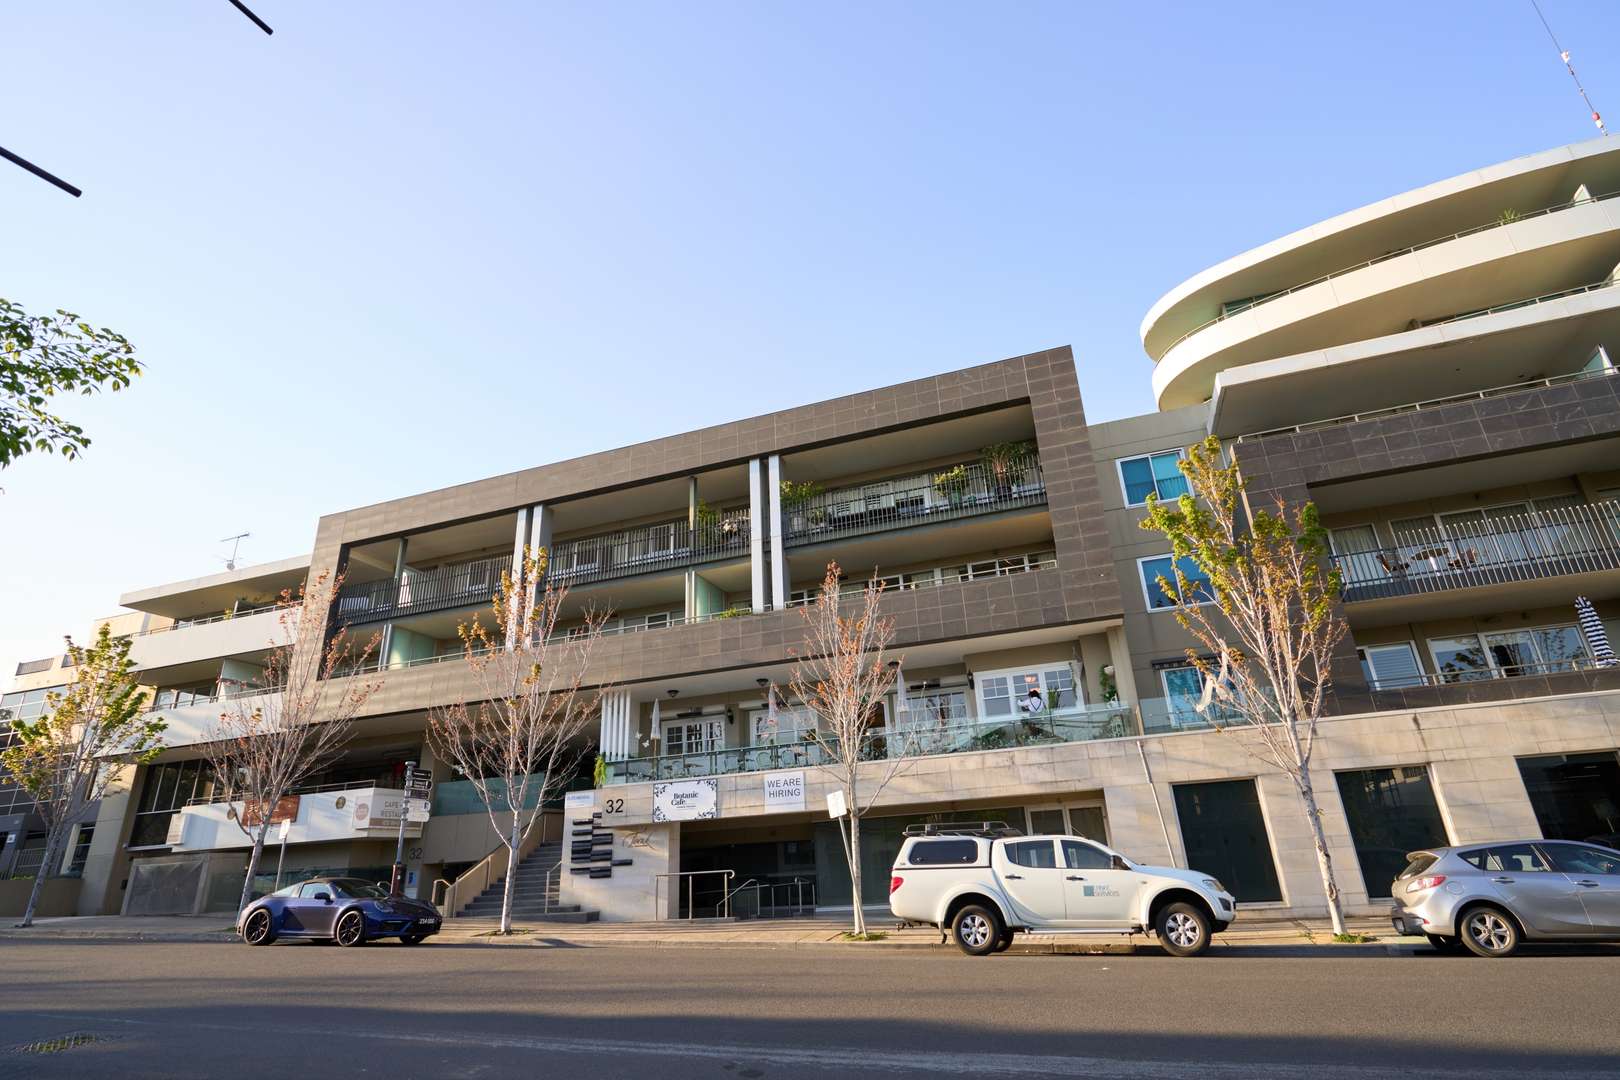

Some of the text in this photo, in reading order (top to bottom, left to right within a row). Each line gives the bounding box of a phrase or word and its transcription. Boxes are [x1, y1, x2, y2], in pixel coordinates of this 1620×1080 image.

[767, 778, 801, 788] WE ARE
[673, 790, 700, 800] Botanic
[768, 788, 801, 798] HIRING
[605, 798, 625, 814] 32
[408, 847, 424, 860] 32
